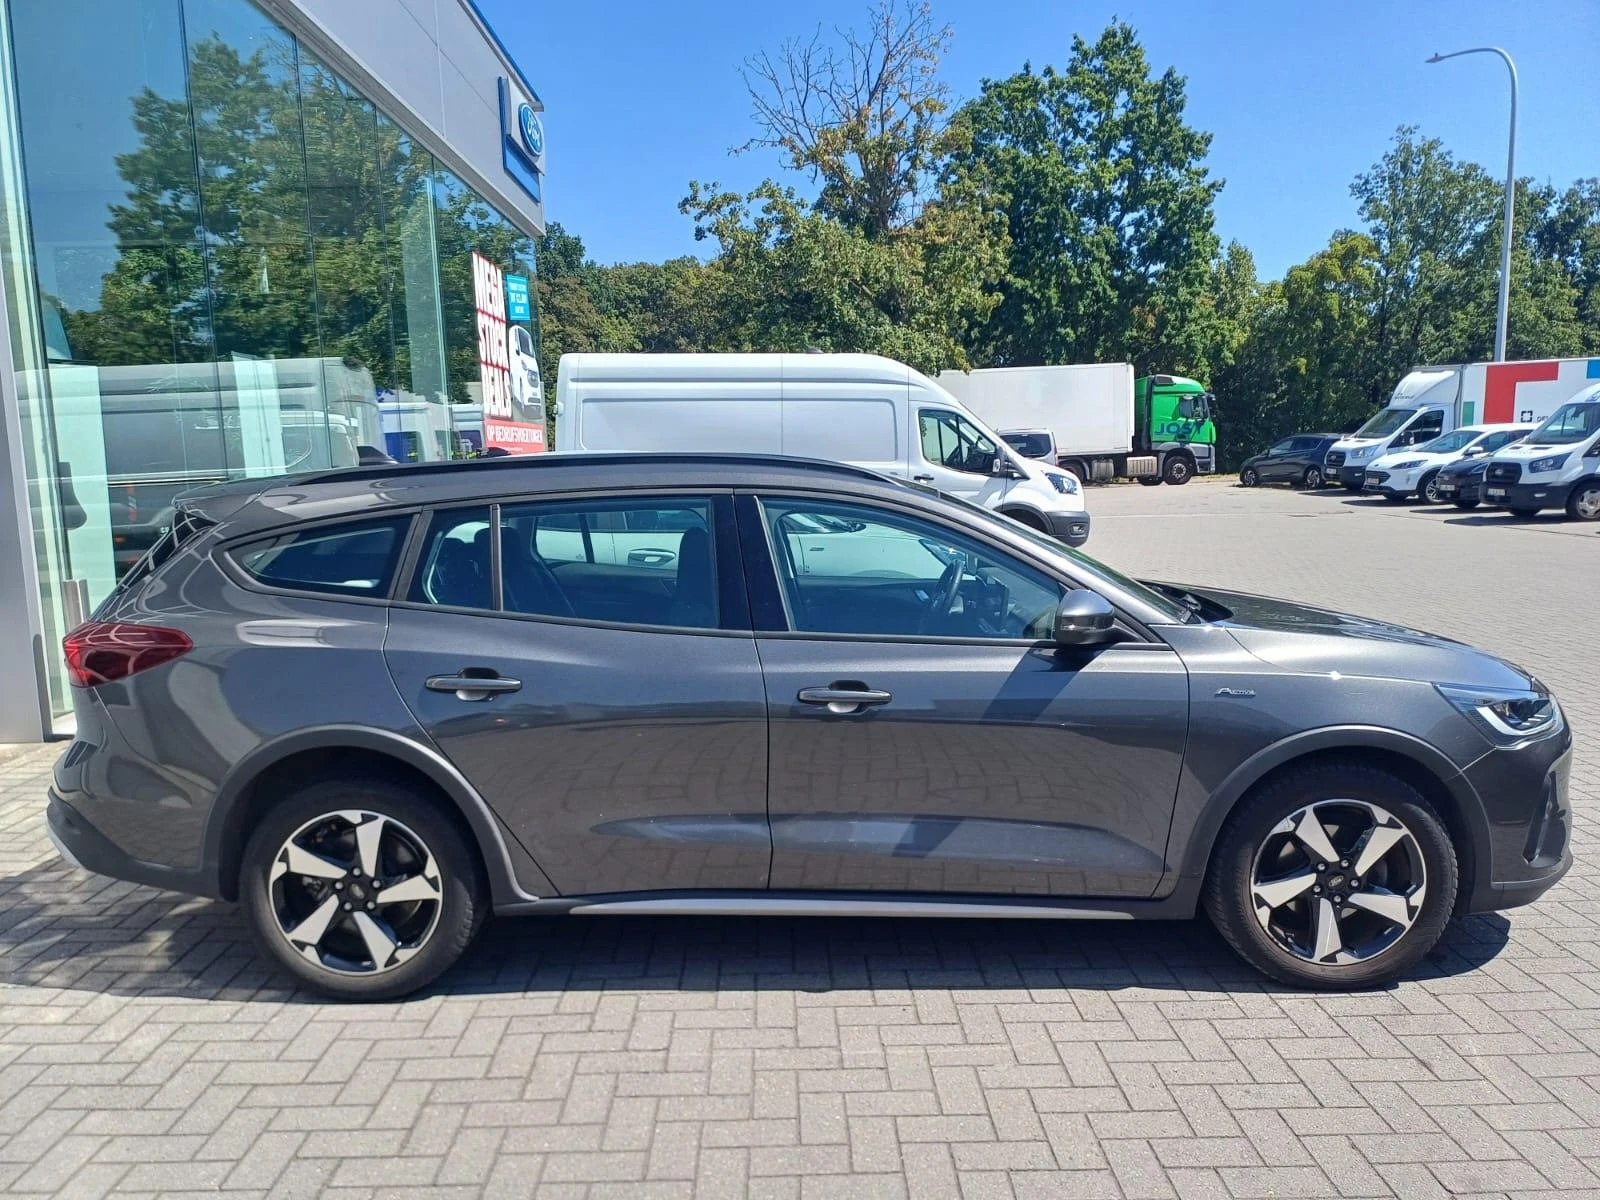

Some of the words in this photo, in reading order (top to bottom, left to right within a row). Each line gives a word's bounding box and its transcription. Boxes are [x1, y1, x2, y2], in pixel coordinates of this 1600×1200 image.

[472, 251, 507, 322] MEGA
[477, 311, 510, 370] STOCK
[481, 364, 513, 418] DEALS
